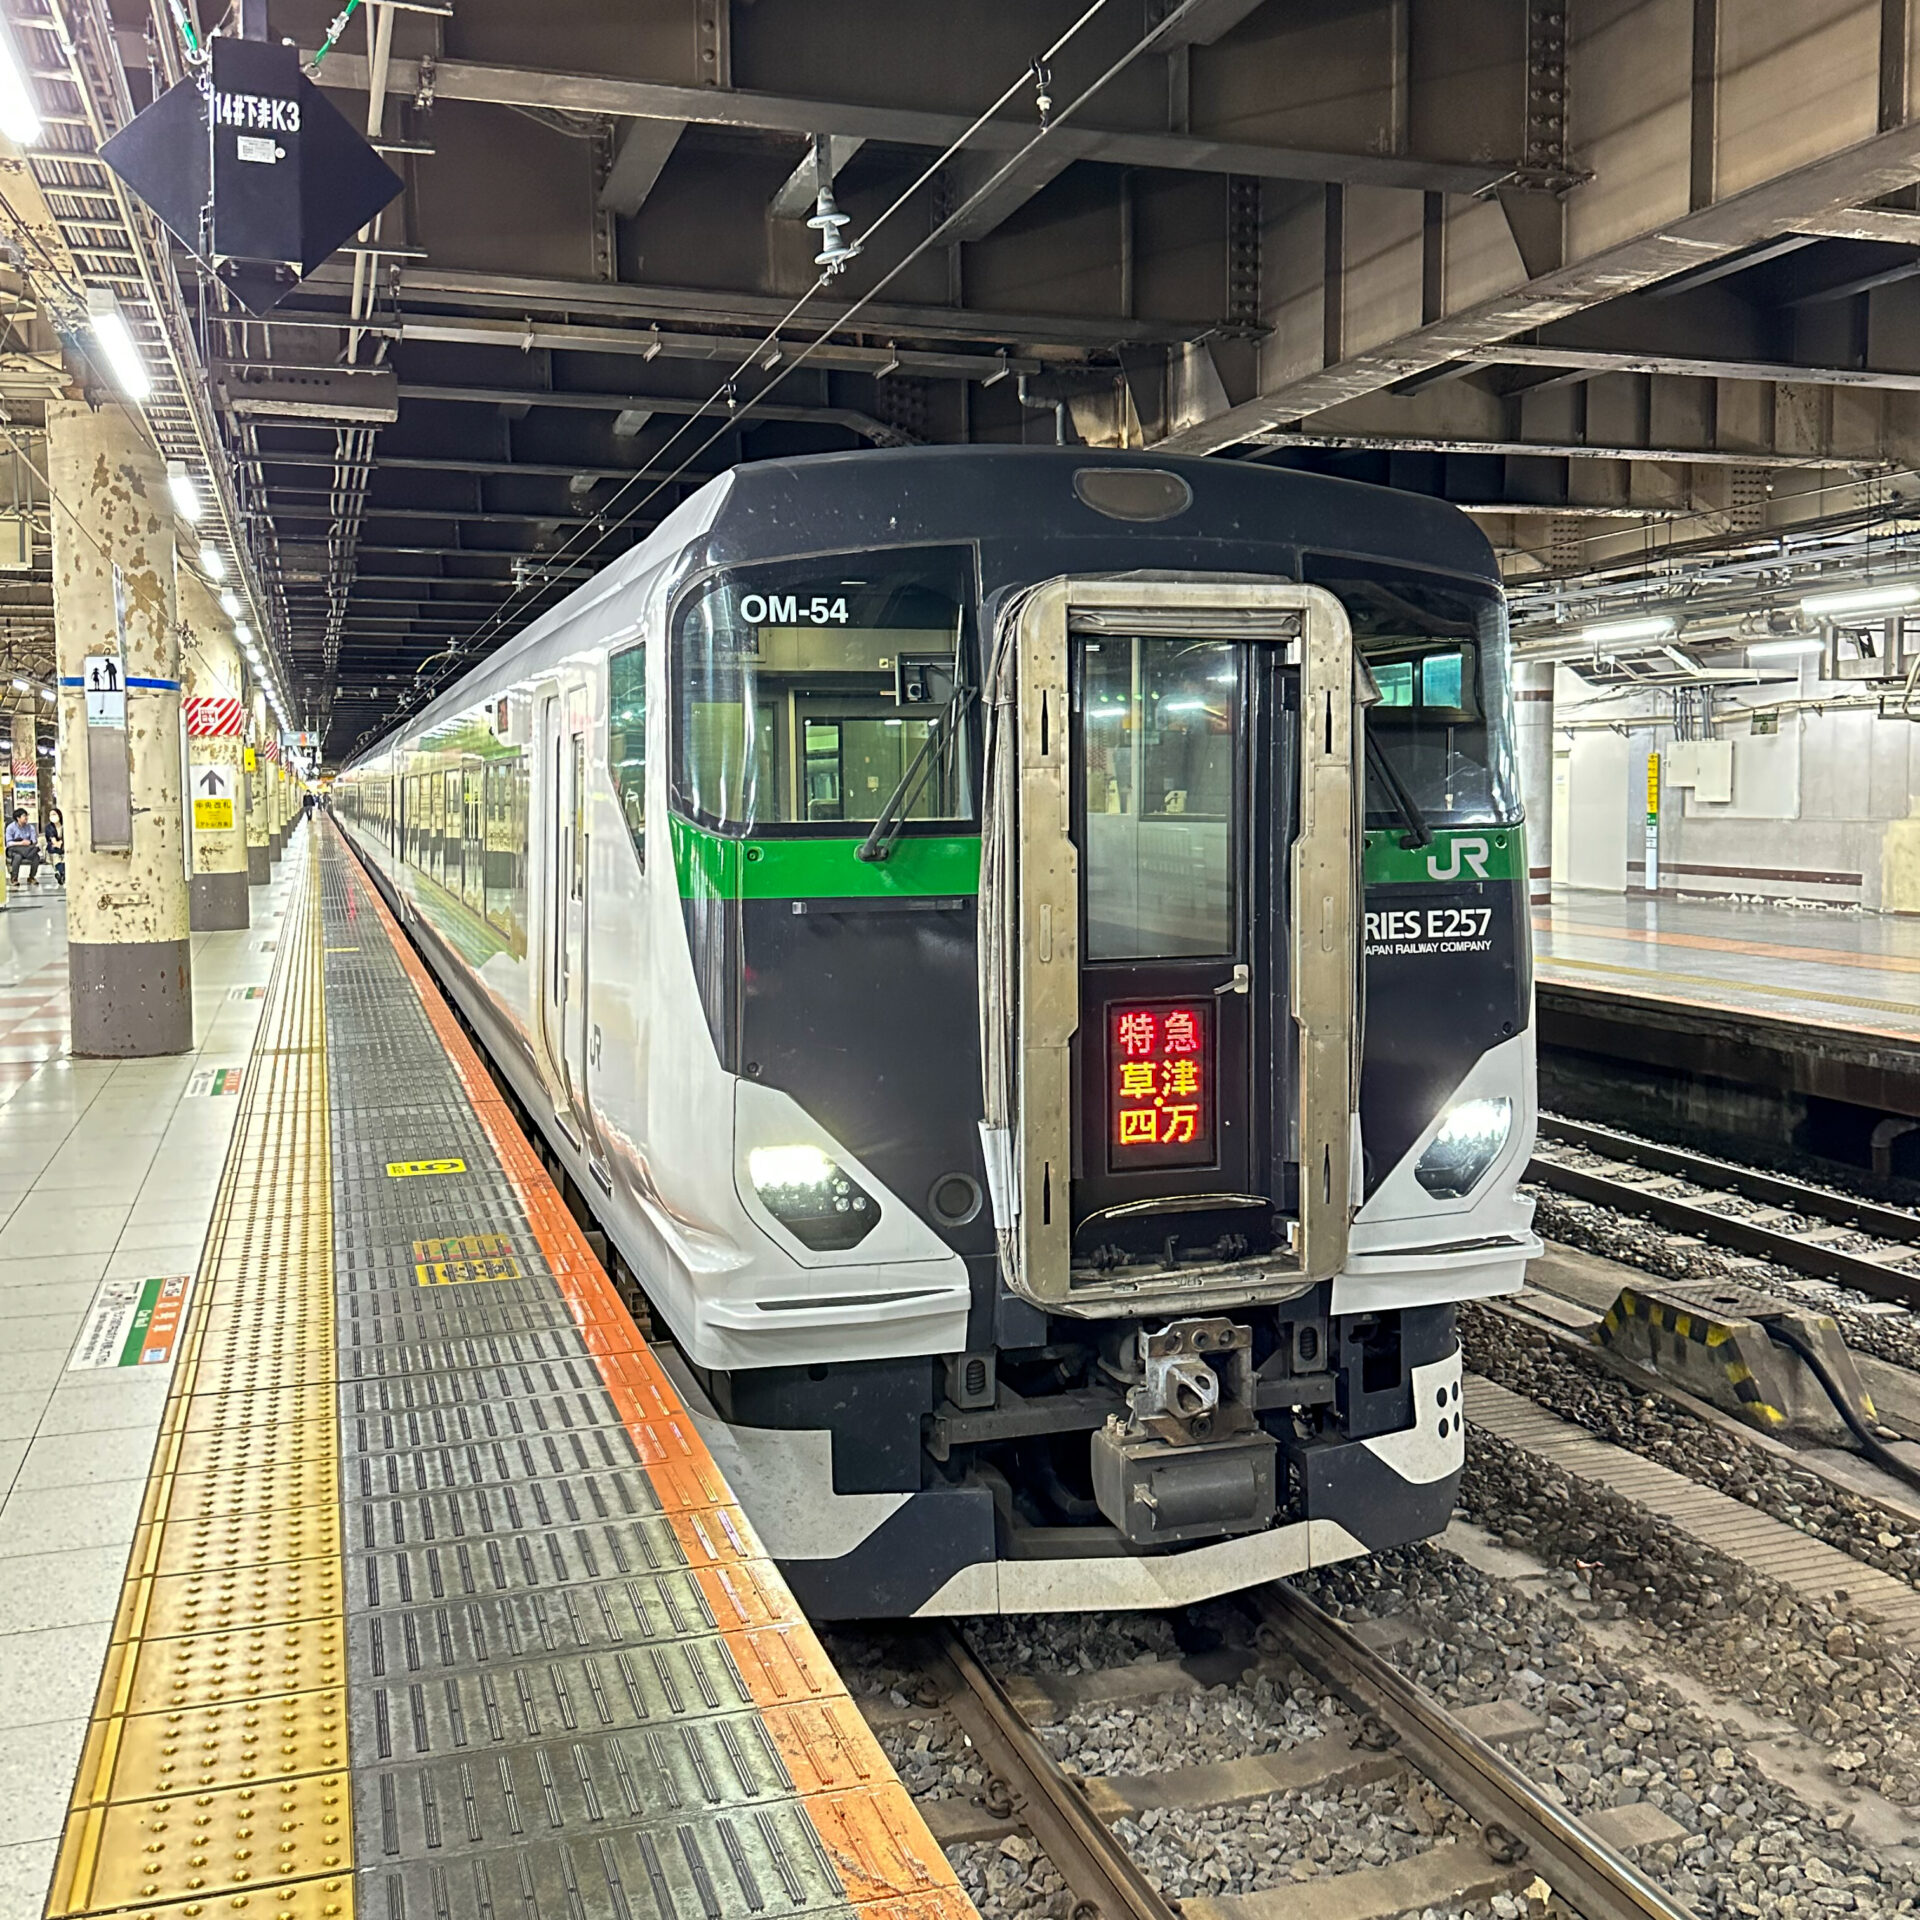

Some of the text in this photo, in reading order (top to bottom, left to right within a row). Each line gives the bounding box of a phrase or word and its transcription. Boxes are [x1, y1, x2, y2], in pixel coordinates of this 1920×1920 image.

[740, 595, 849, 624] OM-54
[1427, 837, 1490, 880] JR
[1364, 908, 1492, 940] RIES E257
[1365, 940, 1492, 956] APAN RAILWAY COMPANY
[1119, 1011, 1199, 1055] 特急
